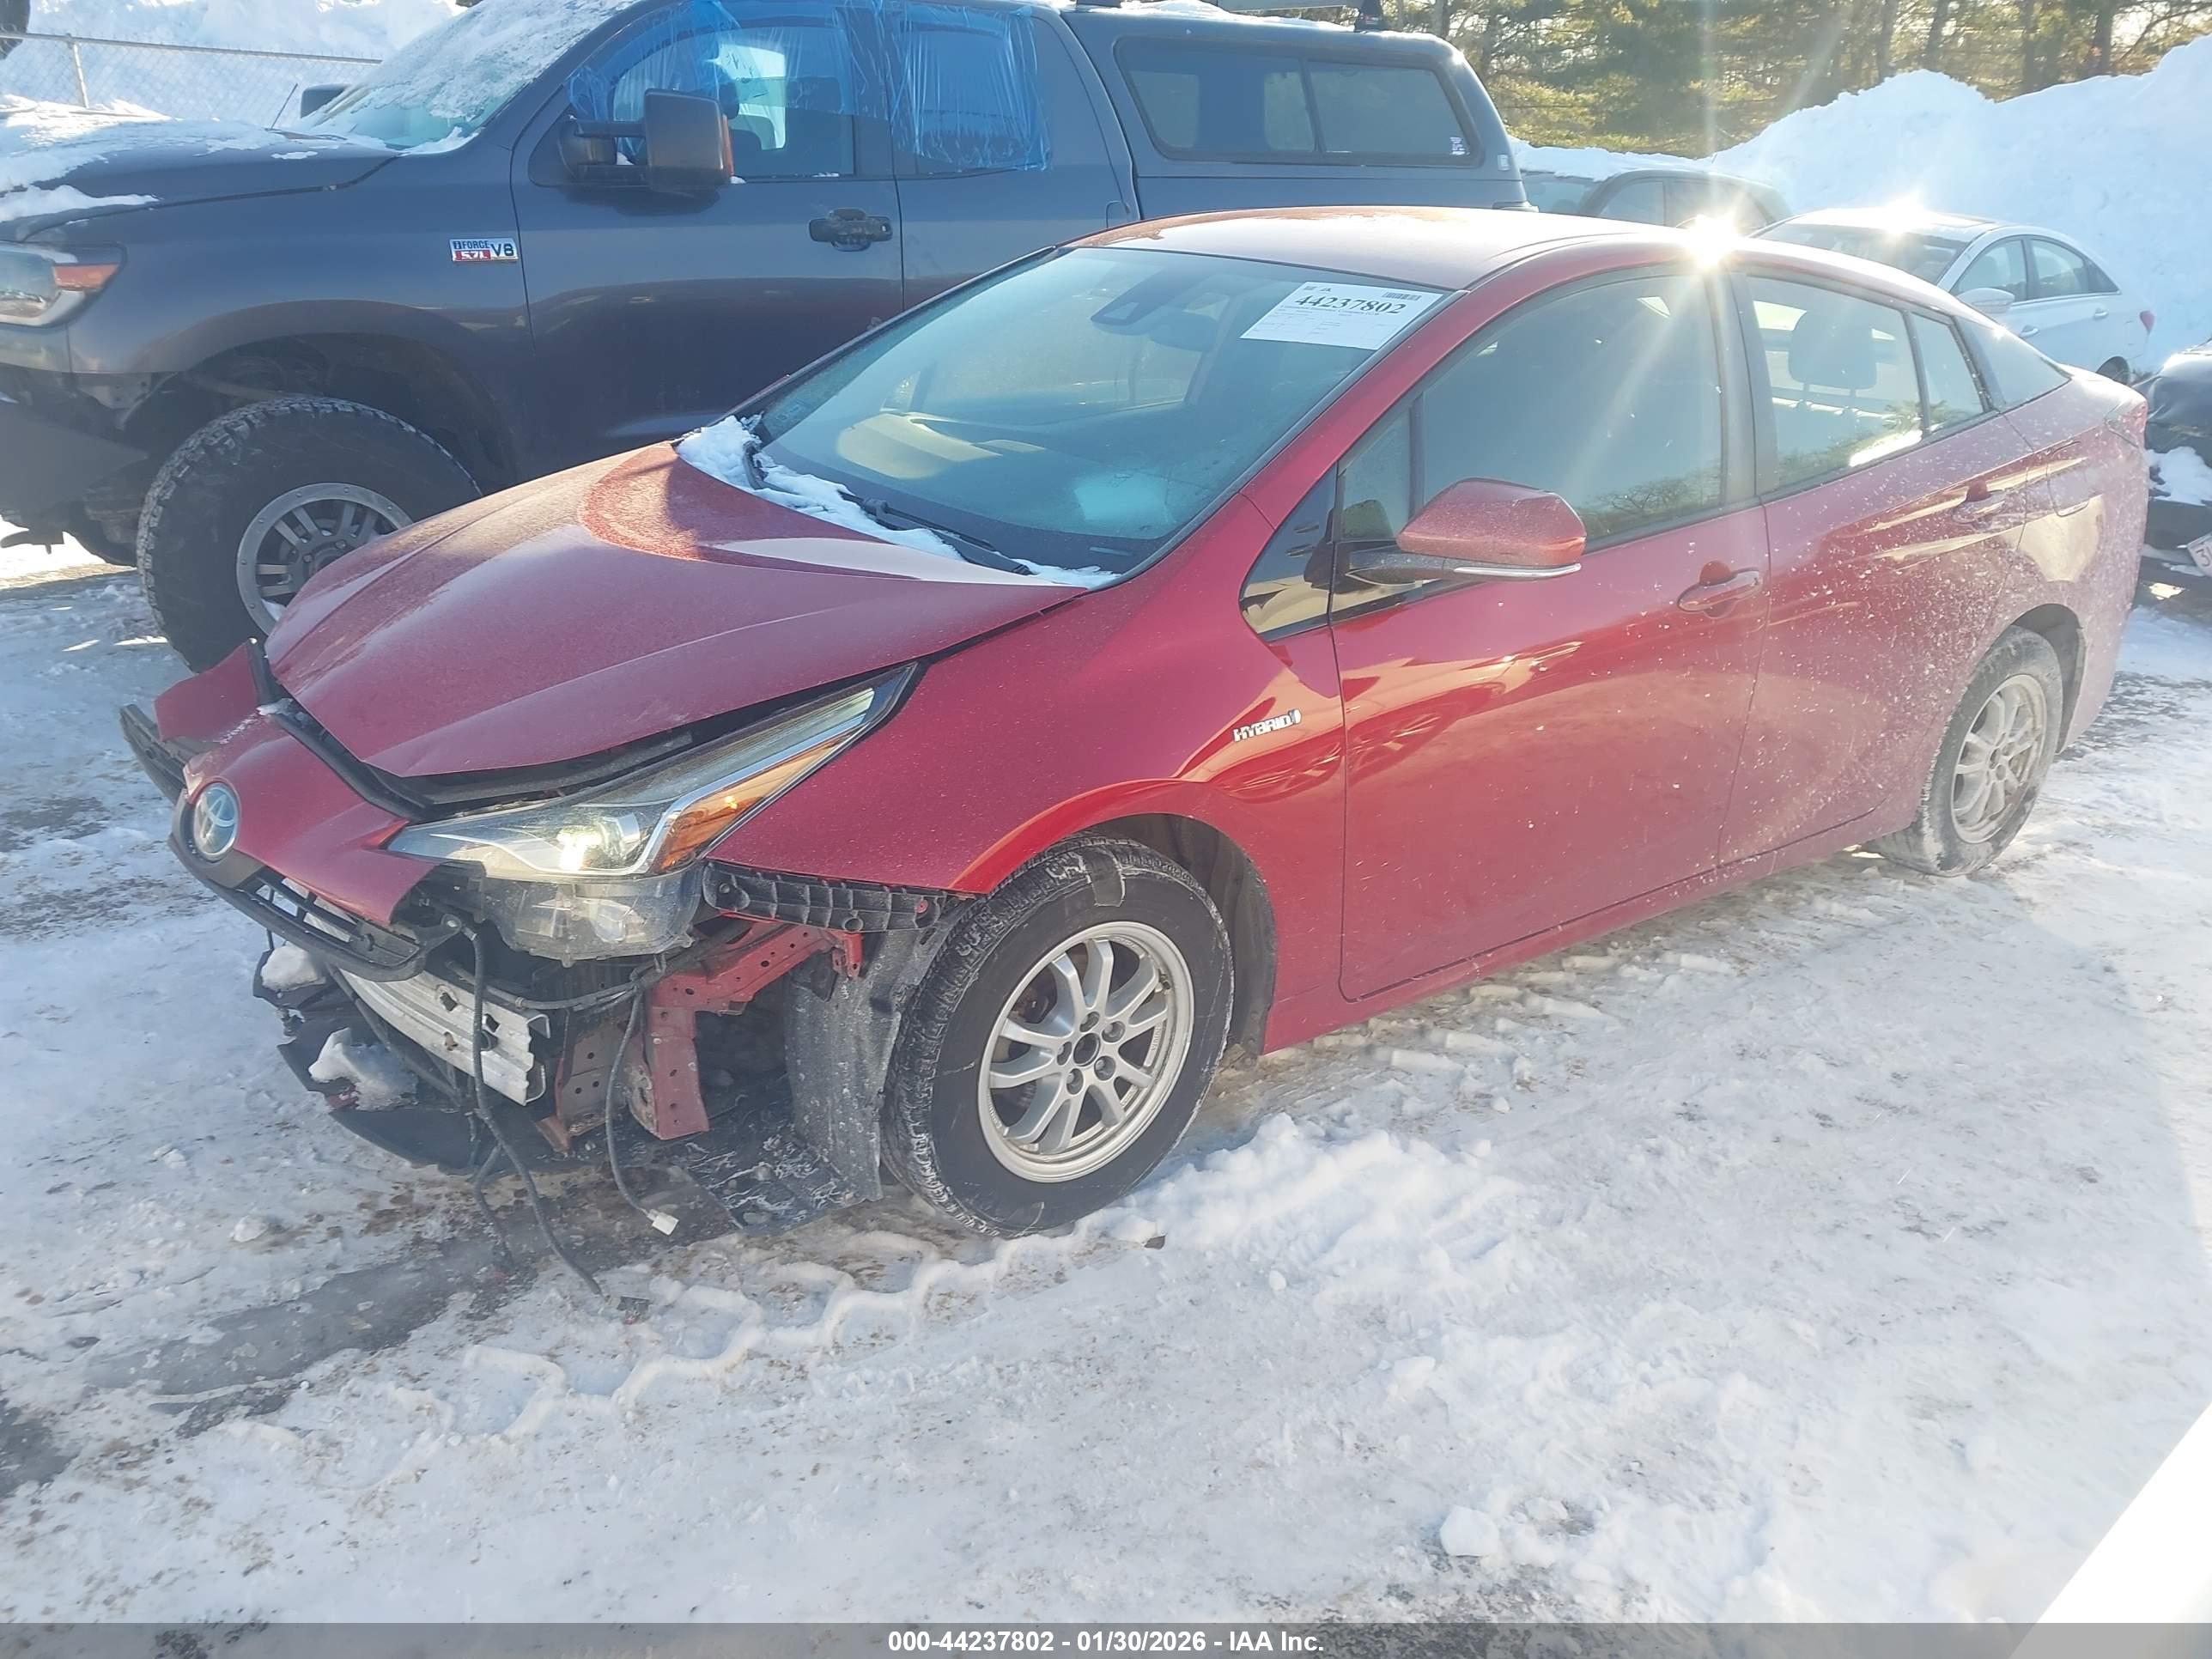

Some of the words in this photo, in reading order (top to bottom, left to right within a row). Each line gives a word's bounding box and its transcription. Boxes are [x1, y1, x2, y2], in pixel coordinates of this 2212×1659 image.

[490, 243, 514, 257] V8
[1295, 295, 1407, 314] 44237802
[1233, 714, 1293, 742] HYBRID
